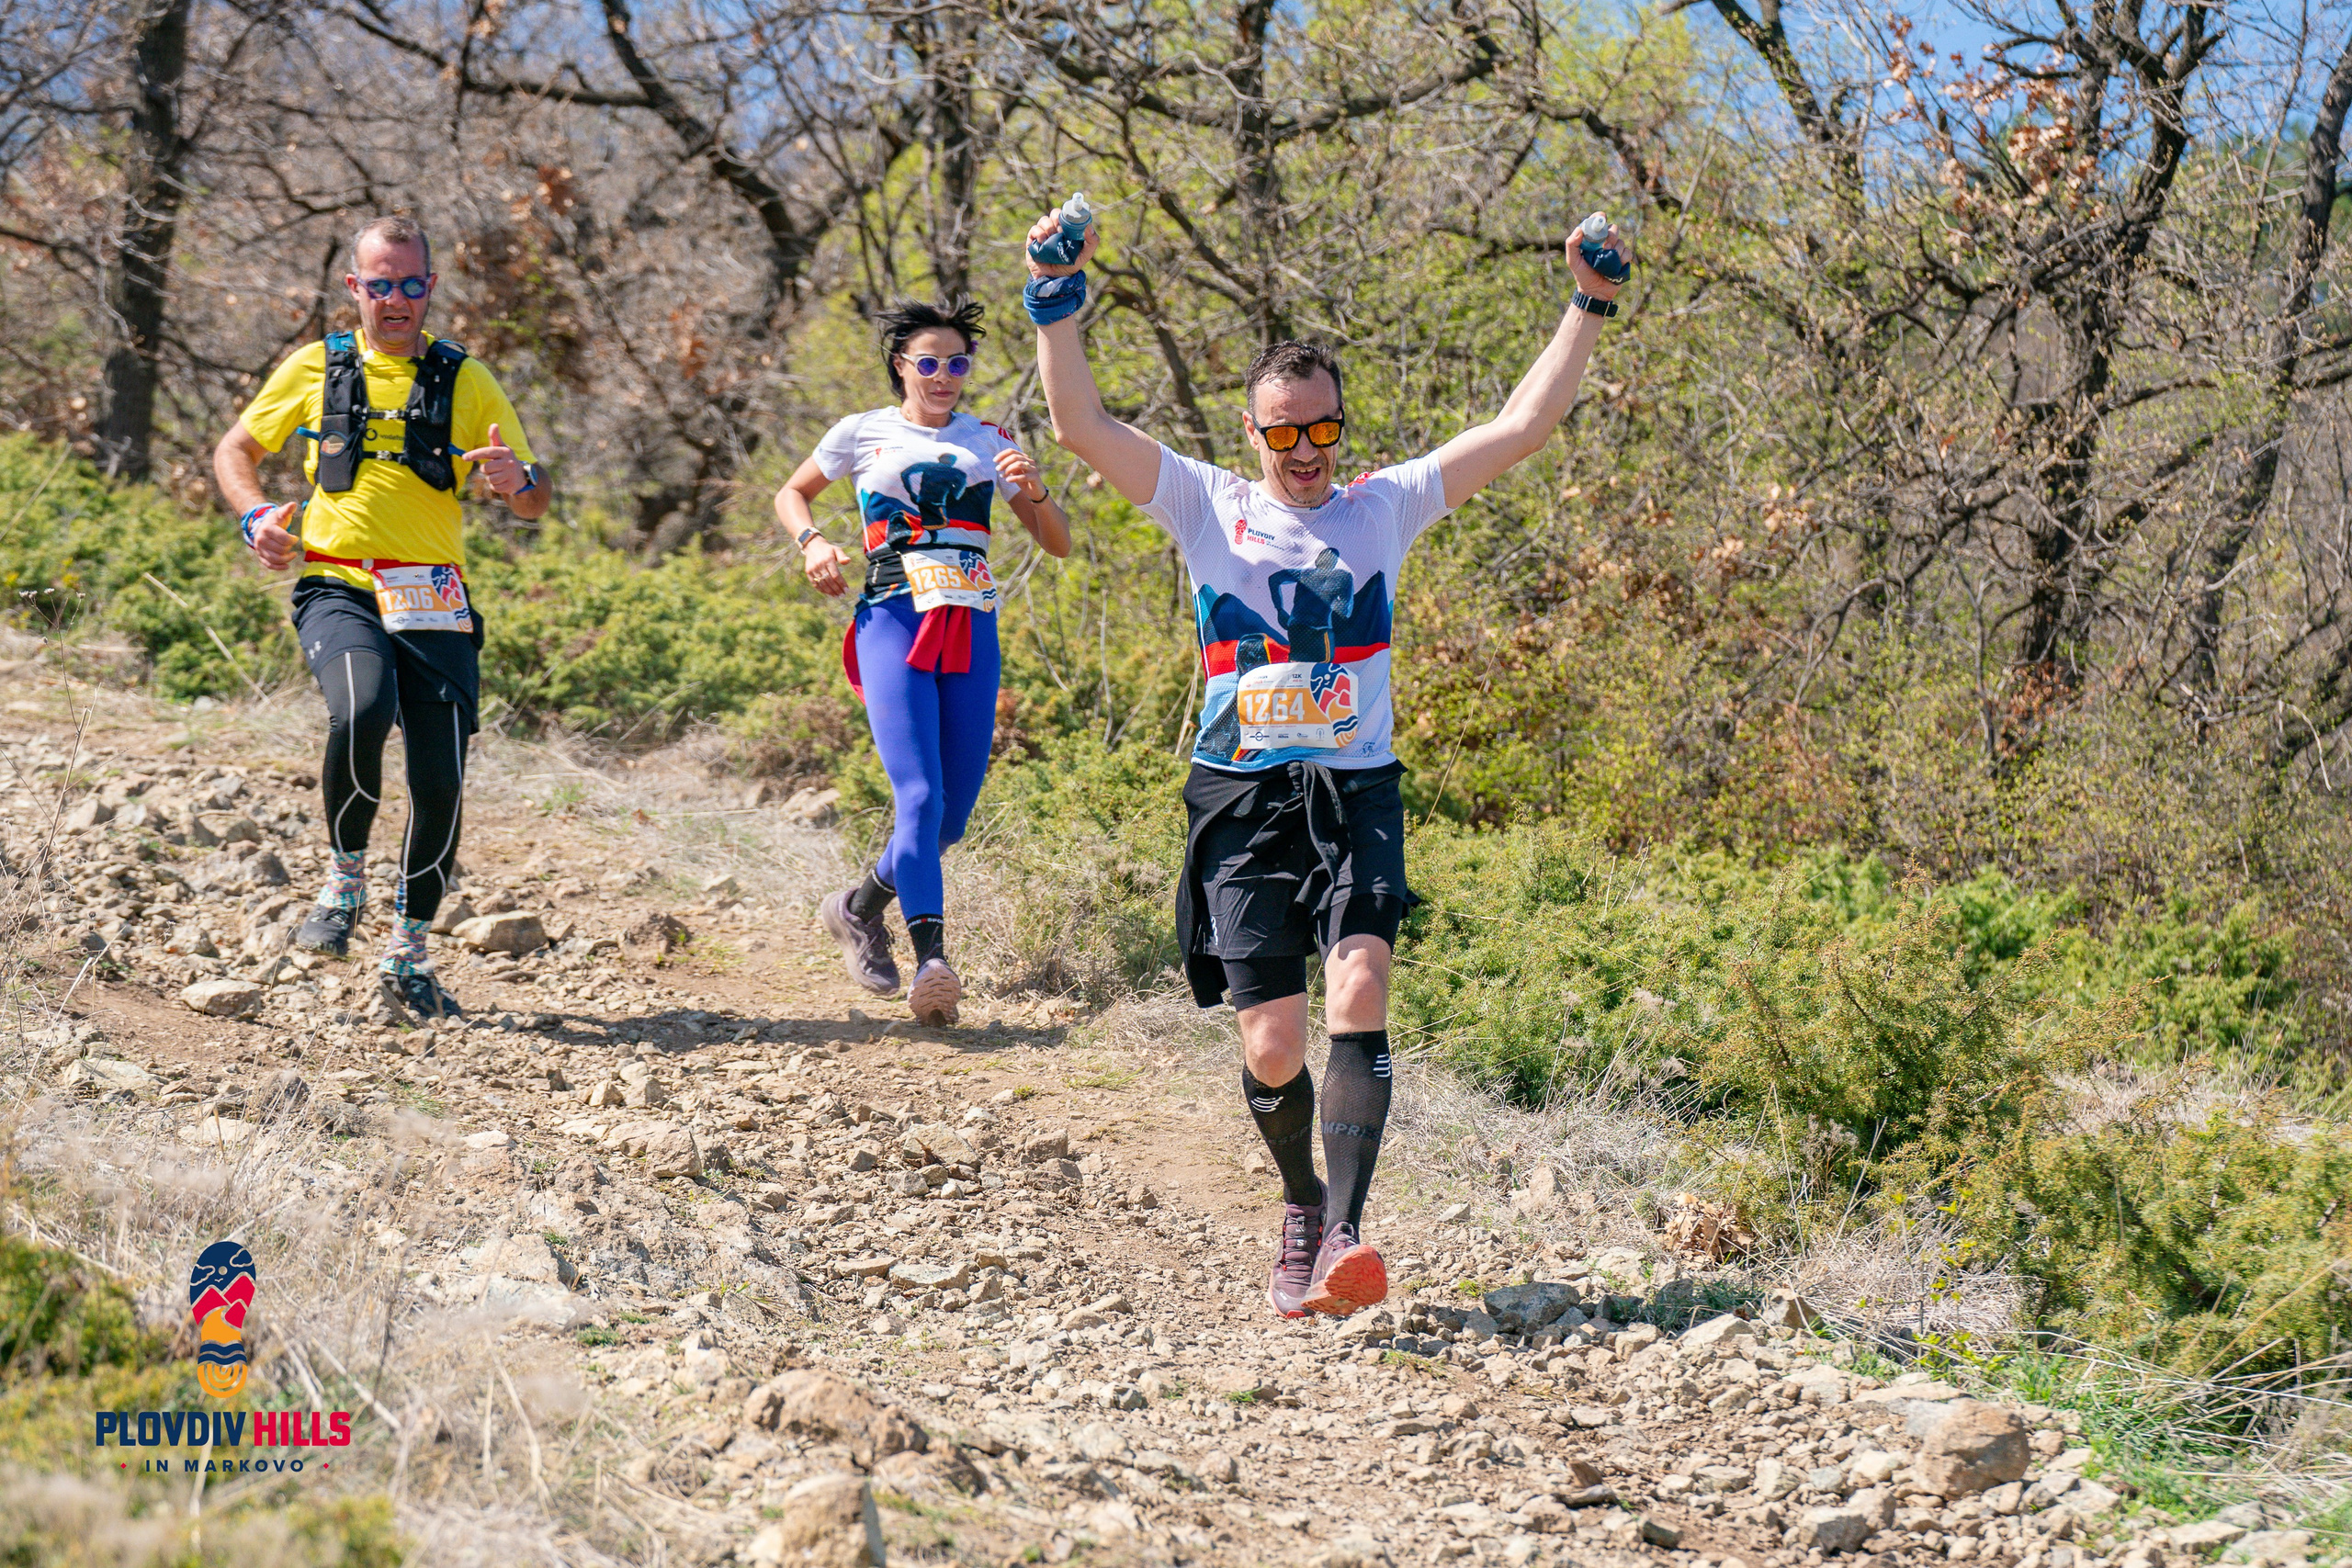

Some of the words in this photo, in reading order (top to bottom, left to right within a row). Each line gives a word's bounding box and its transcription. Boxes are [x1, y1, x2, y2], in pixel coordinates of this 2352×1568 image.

[1247, 535, 1265, 545] HILLS
[1248, 528, 1275, 541] PLOVDIV
[911, 567, 961, 592] 1265
[379, 587, 434, 612] 1206
[1244, 692, 1306, 723] 1264
